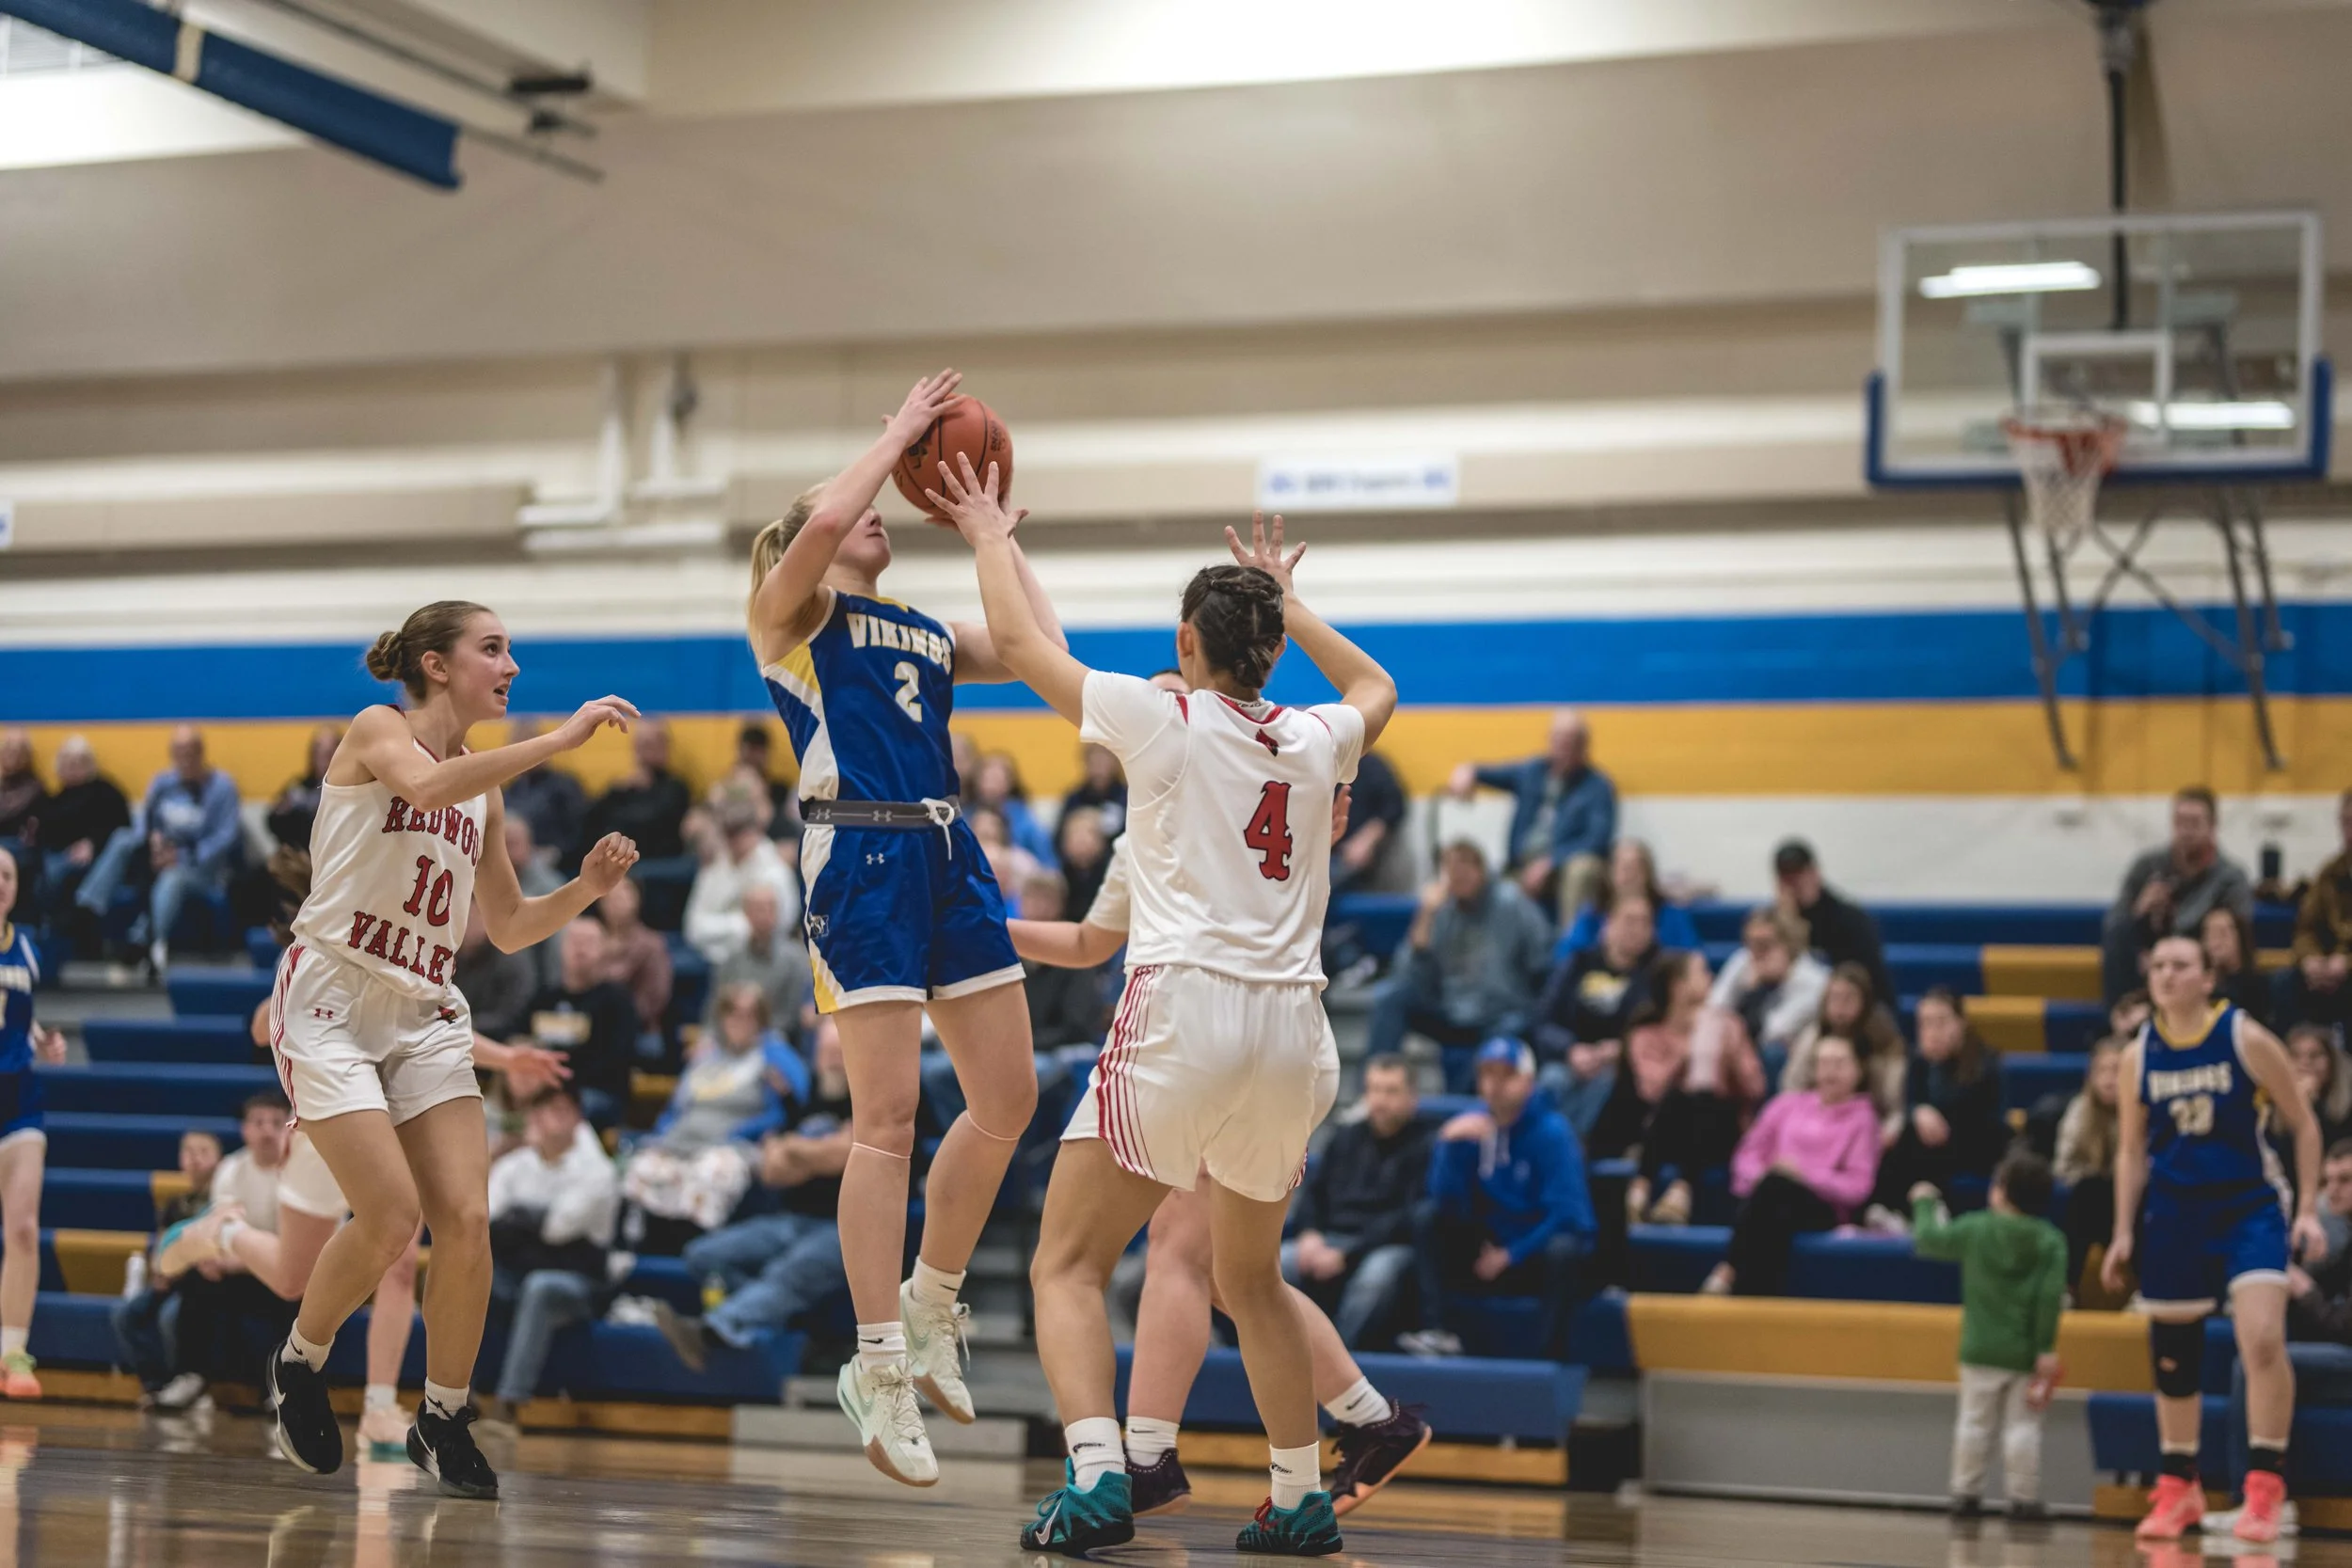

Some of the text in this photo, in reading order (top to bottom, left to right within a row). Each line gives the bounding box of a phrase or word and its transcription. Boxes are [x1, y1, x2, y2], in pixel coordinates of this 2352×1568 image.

[846, 612, 952, 675] VIKINGS
[894, 660, 923, 722] 2
[382, 796, 481, 867] REDWOO
[1243, 780, 1294, 881] 4
[403, 854, 453, 927] 10
[347, 911, 457, 986] VALLE
